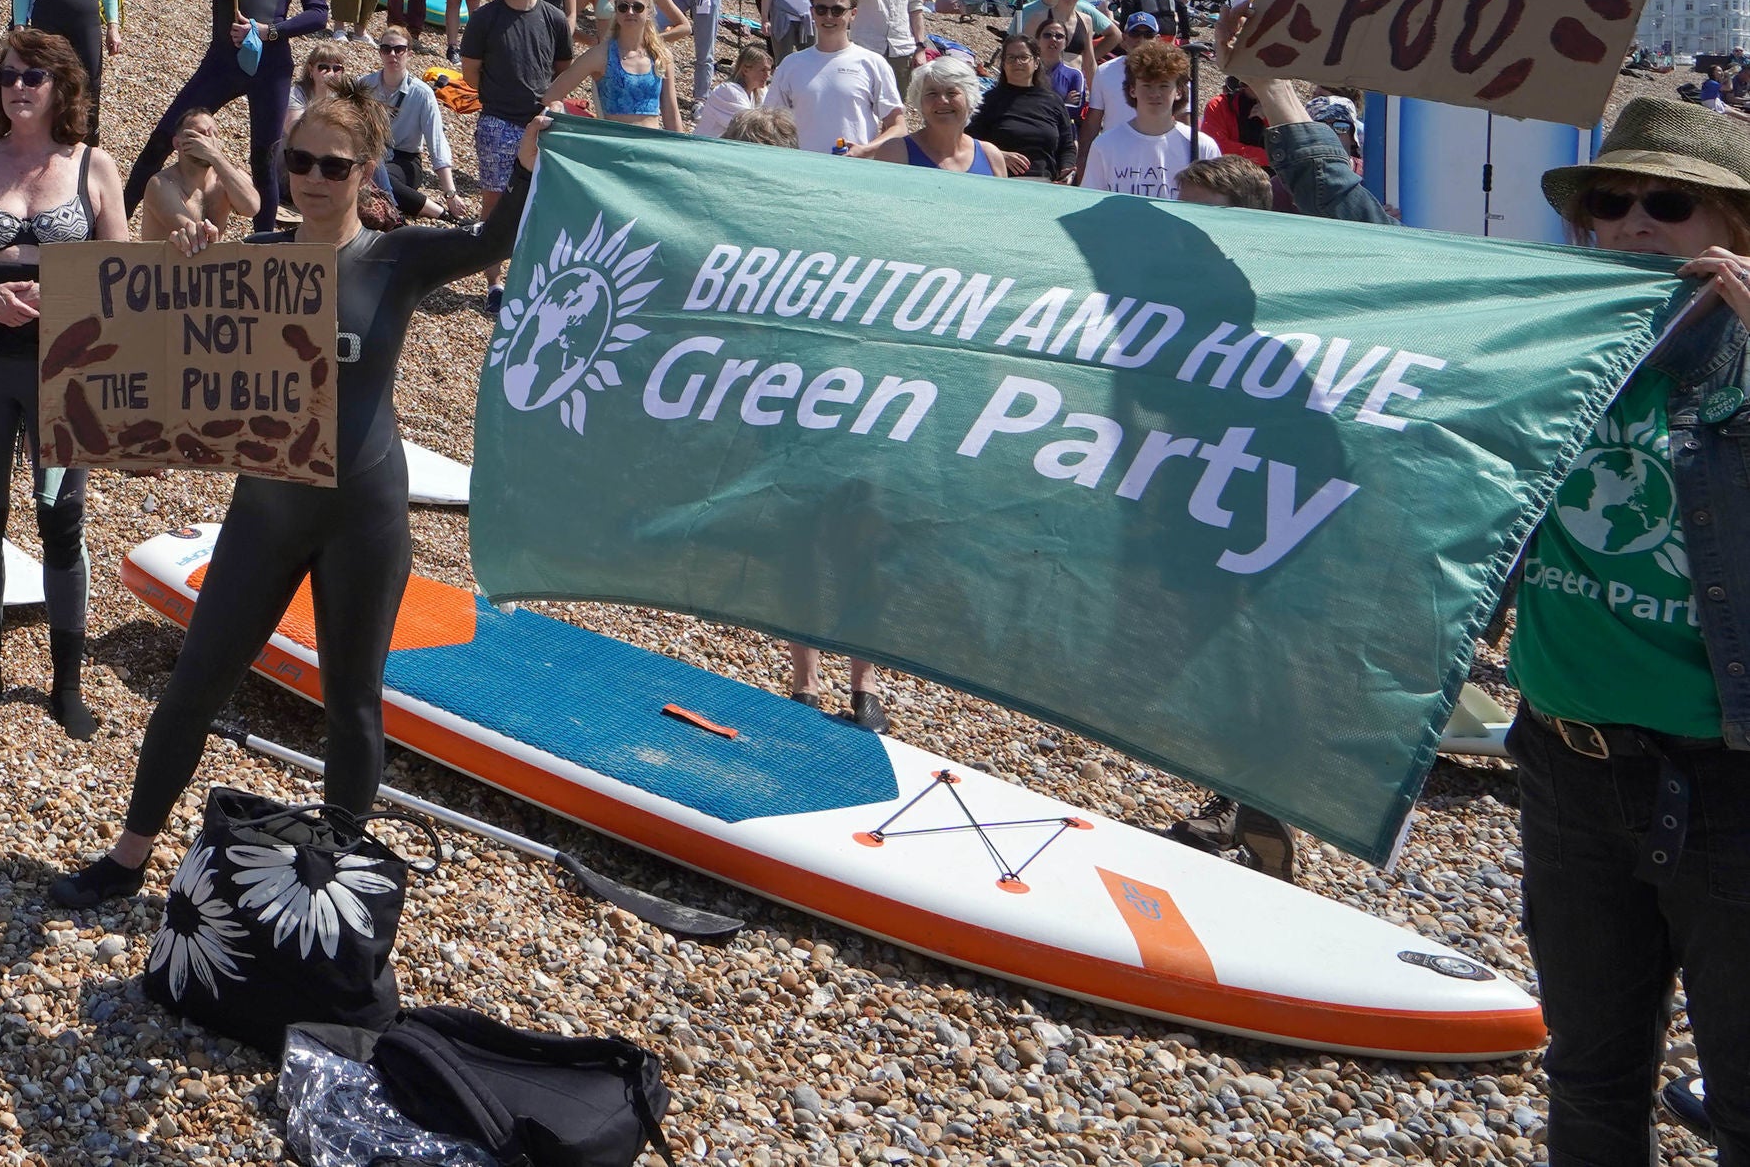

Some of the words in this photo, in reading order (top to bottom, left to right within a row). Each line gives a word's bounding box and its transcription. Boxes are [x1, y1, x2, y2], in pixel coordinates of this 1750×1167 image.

[1114, 166, 1168, 180] WHAT
[99, 257, 260, 319] POLLUTER
[263, 257, 326, 316] PAYS
[182, 314, 259, 356] NOT
[682, 243, 1016, 341] BRIGHTON
[994, 286, 1184, 369] AND
[1174, 321, 1447, 432] HOVE
[85, 372, 148, 411] THE
[181, 367, 301, 414] PUBLIC
[1706, 396, 1736, 416] Green
[1707, 404, 1734, 421] Party
[642, 335, 938, 443] Green
[956, 375, 1360, 575] Party
[1607, 580, 1700, 628] Part
